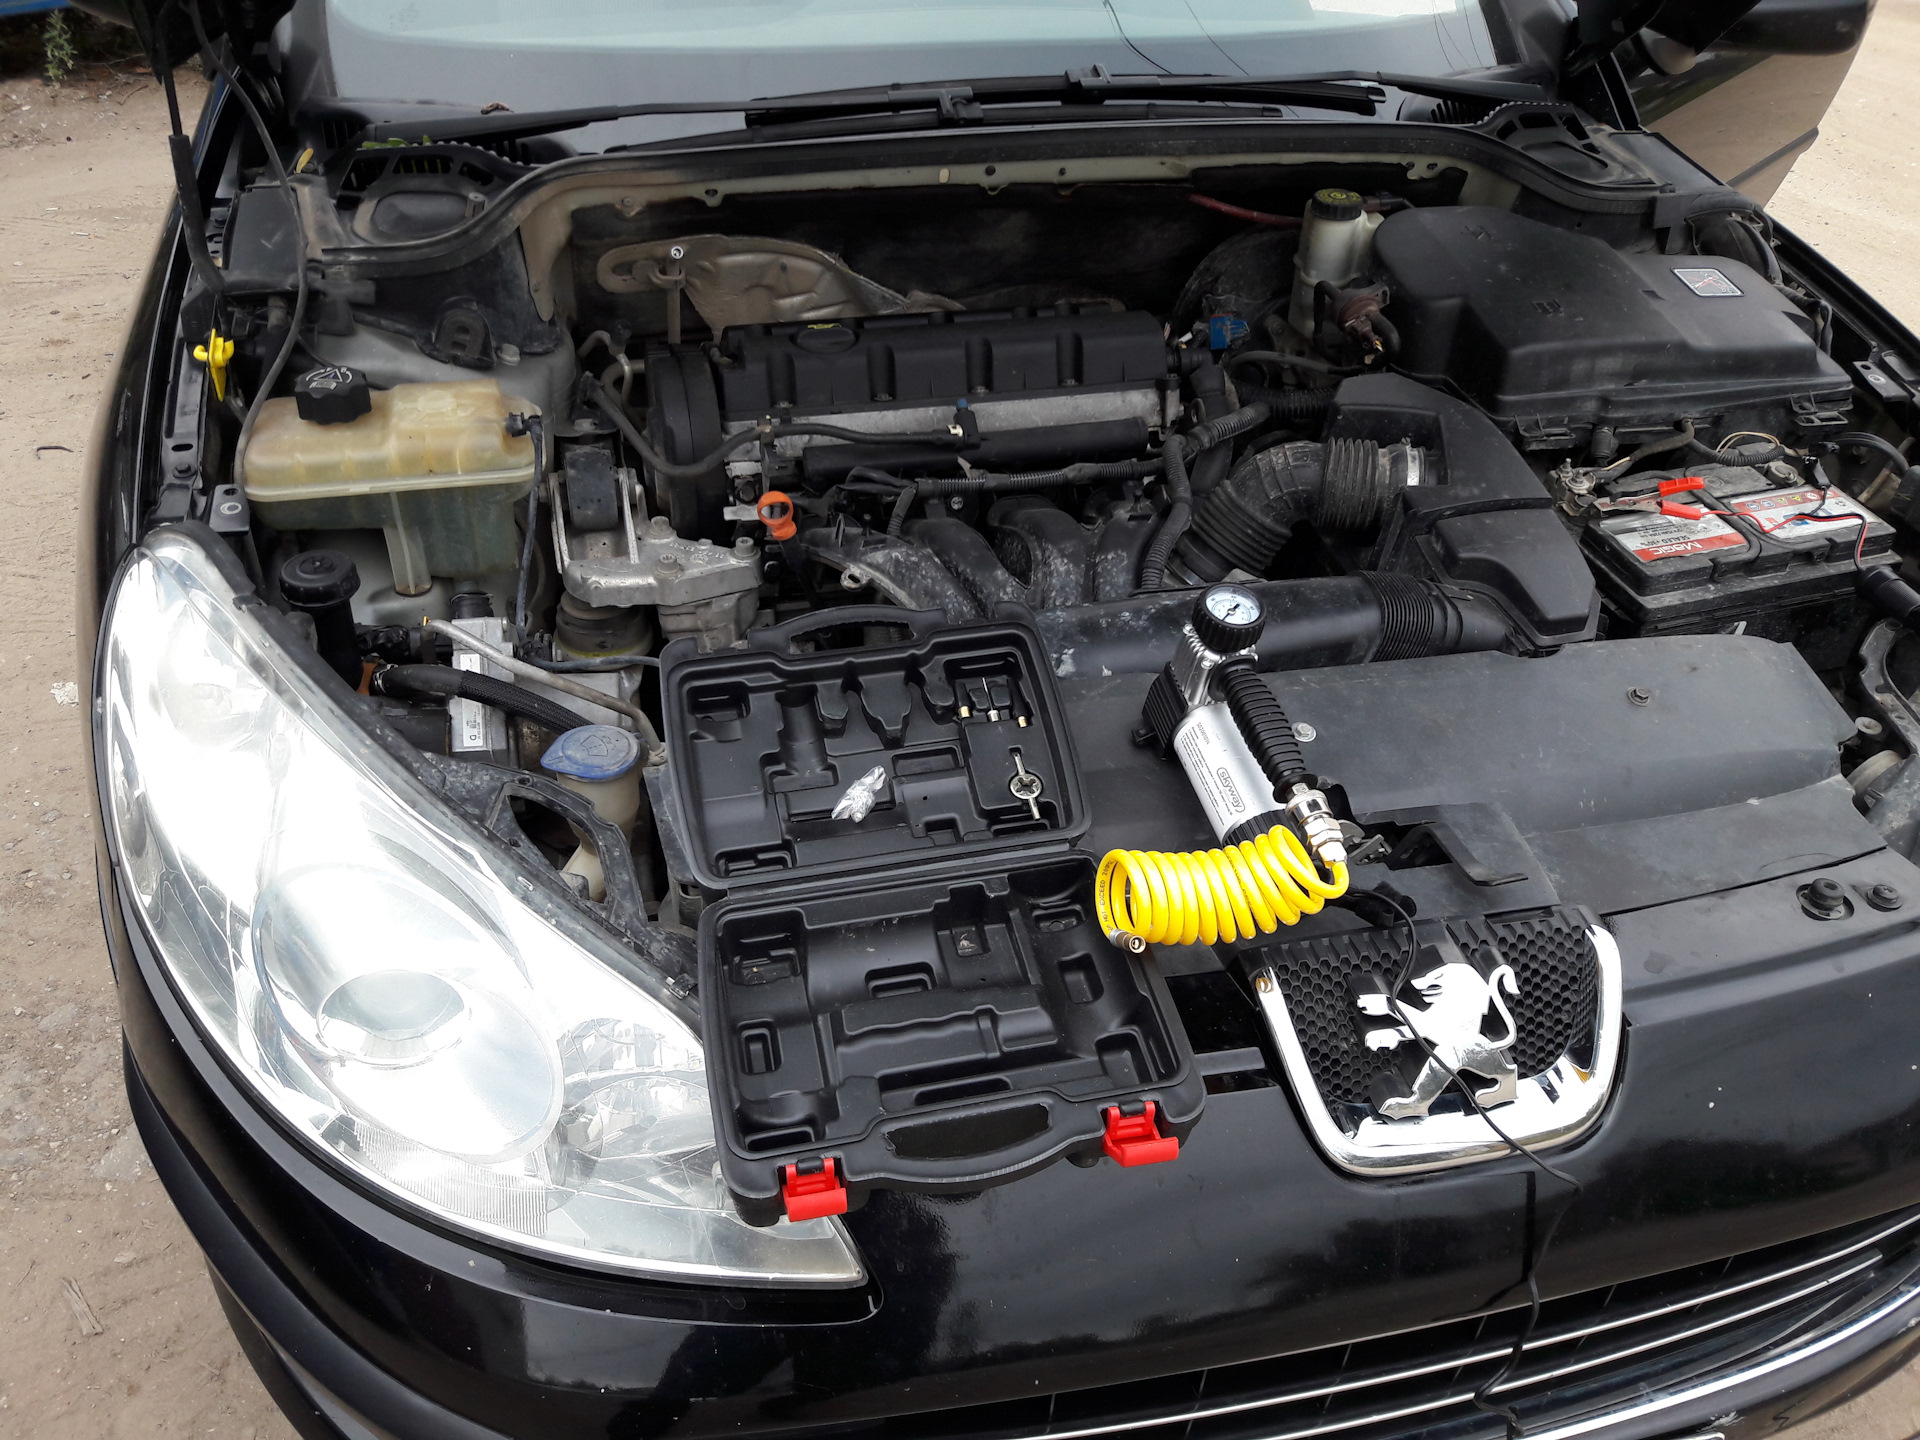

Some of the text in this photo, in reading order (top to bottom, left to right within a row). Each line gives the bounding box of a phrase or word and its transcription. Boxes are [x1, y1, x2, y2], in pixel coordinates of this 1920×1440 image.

[1649, 541, 1703, 555] Magic
[1661, 535, 1691, 544] SEALED
[1219, 771, 1243, 809] skyway
[1098, 879, 1106, 906] EXCEED
